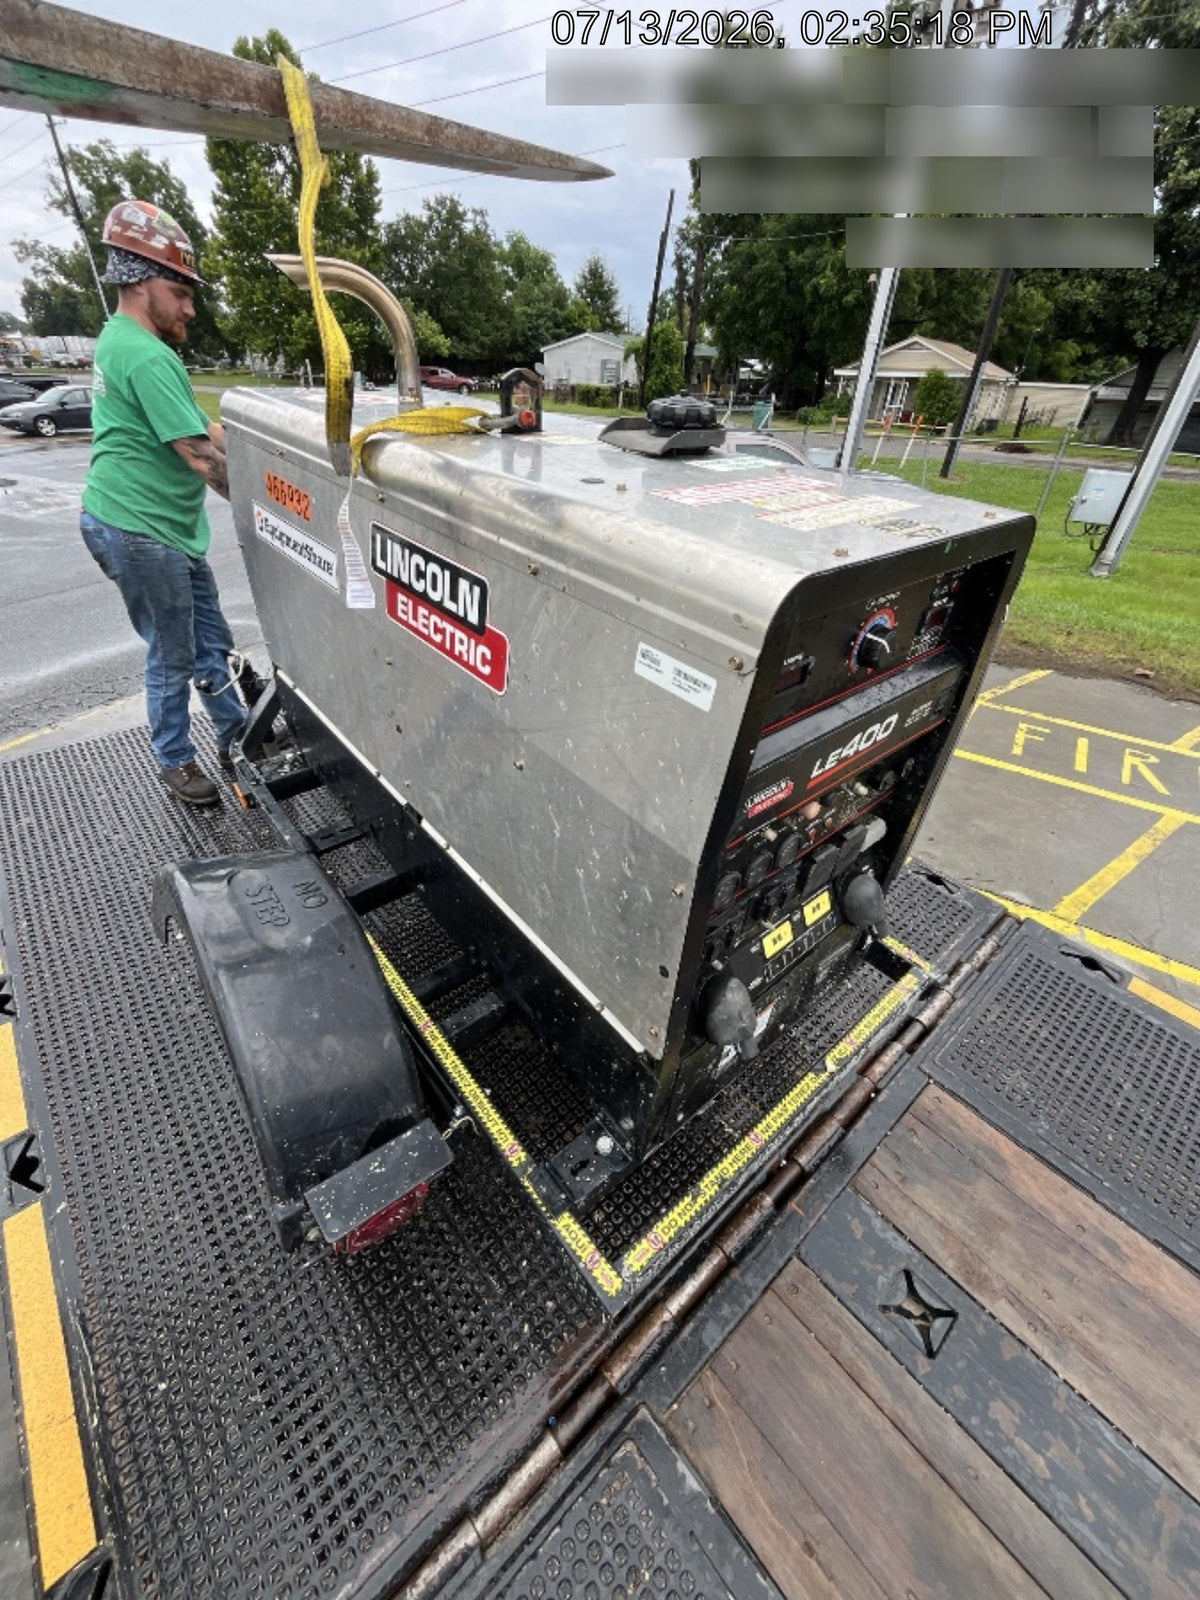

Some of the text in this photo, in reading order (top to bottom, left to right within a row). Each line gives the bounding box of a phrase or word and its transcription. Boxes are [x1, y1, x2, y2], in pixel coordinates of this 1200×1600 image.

[376, 532, 480, 627] LINCOLN
[397, 592, 492, 676] ELECTRIC
[1011, 721, 1200, 796] FIR
[244, 875, 291, 927] STEP
